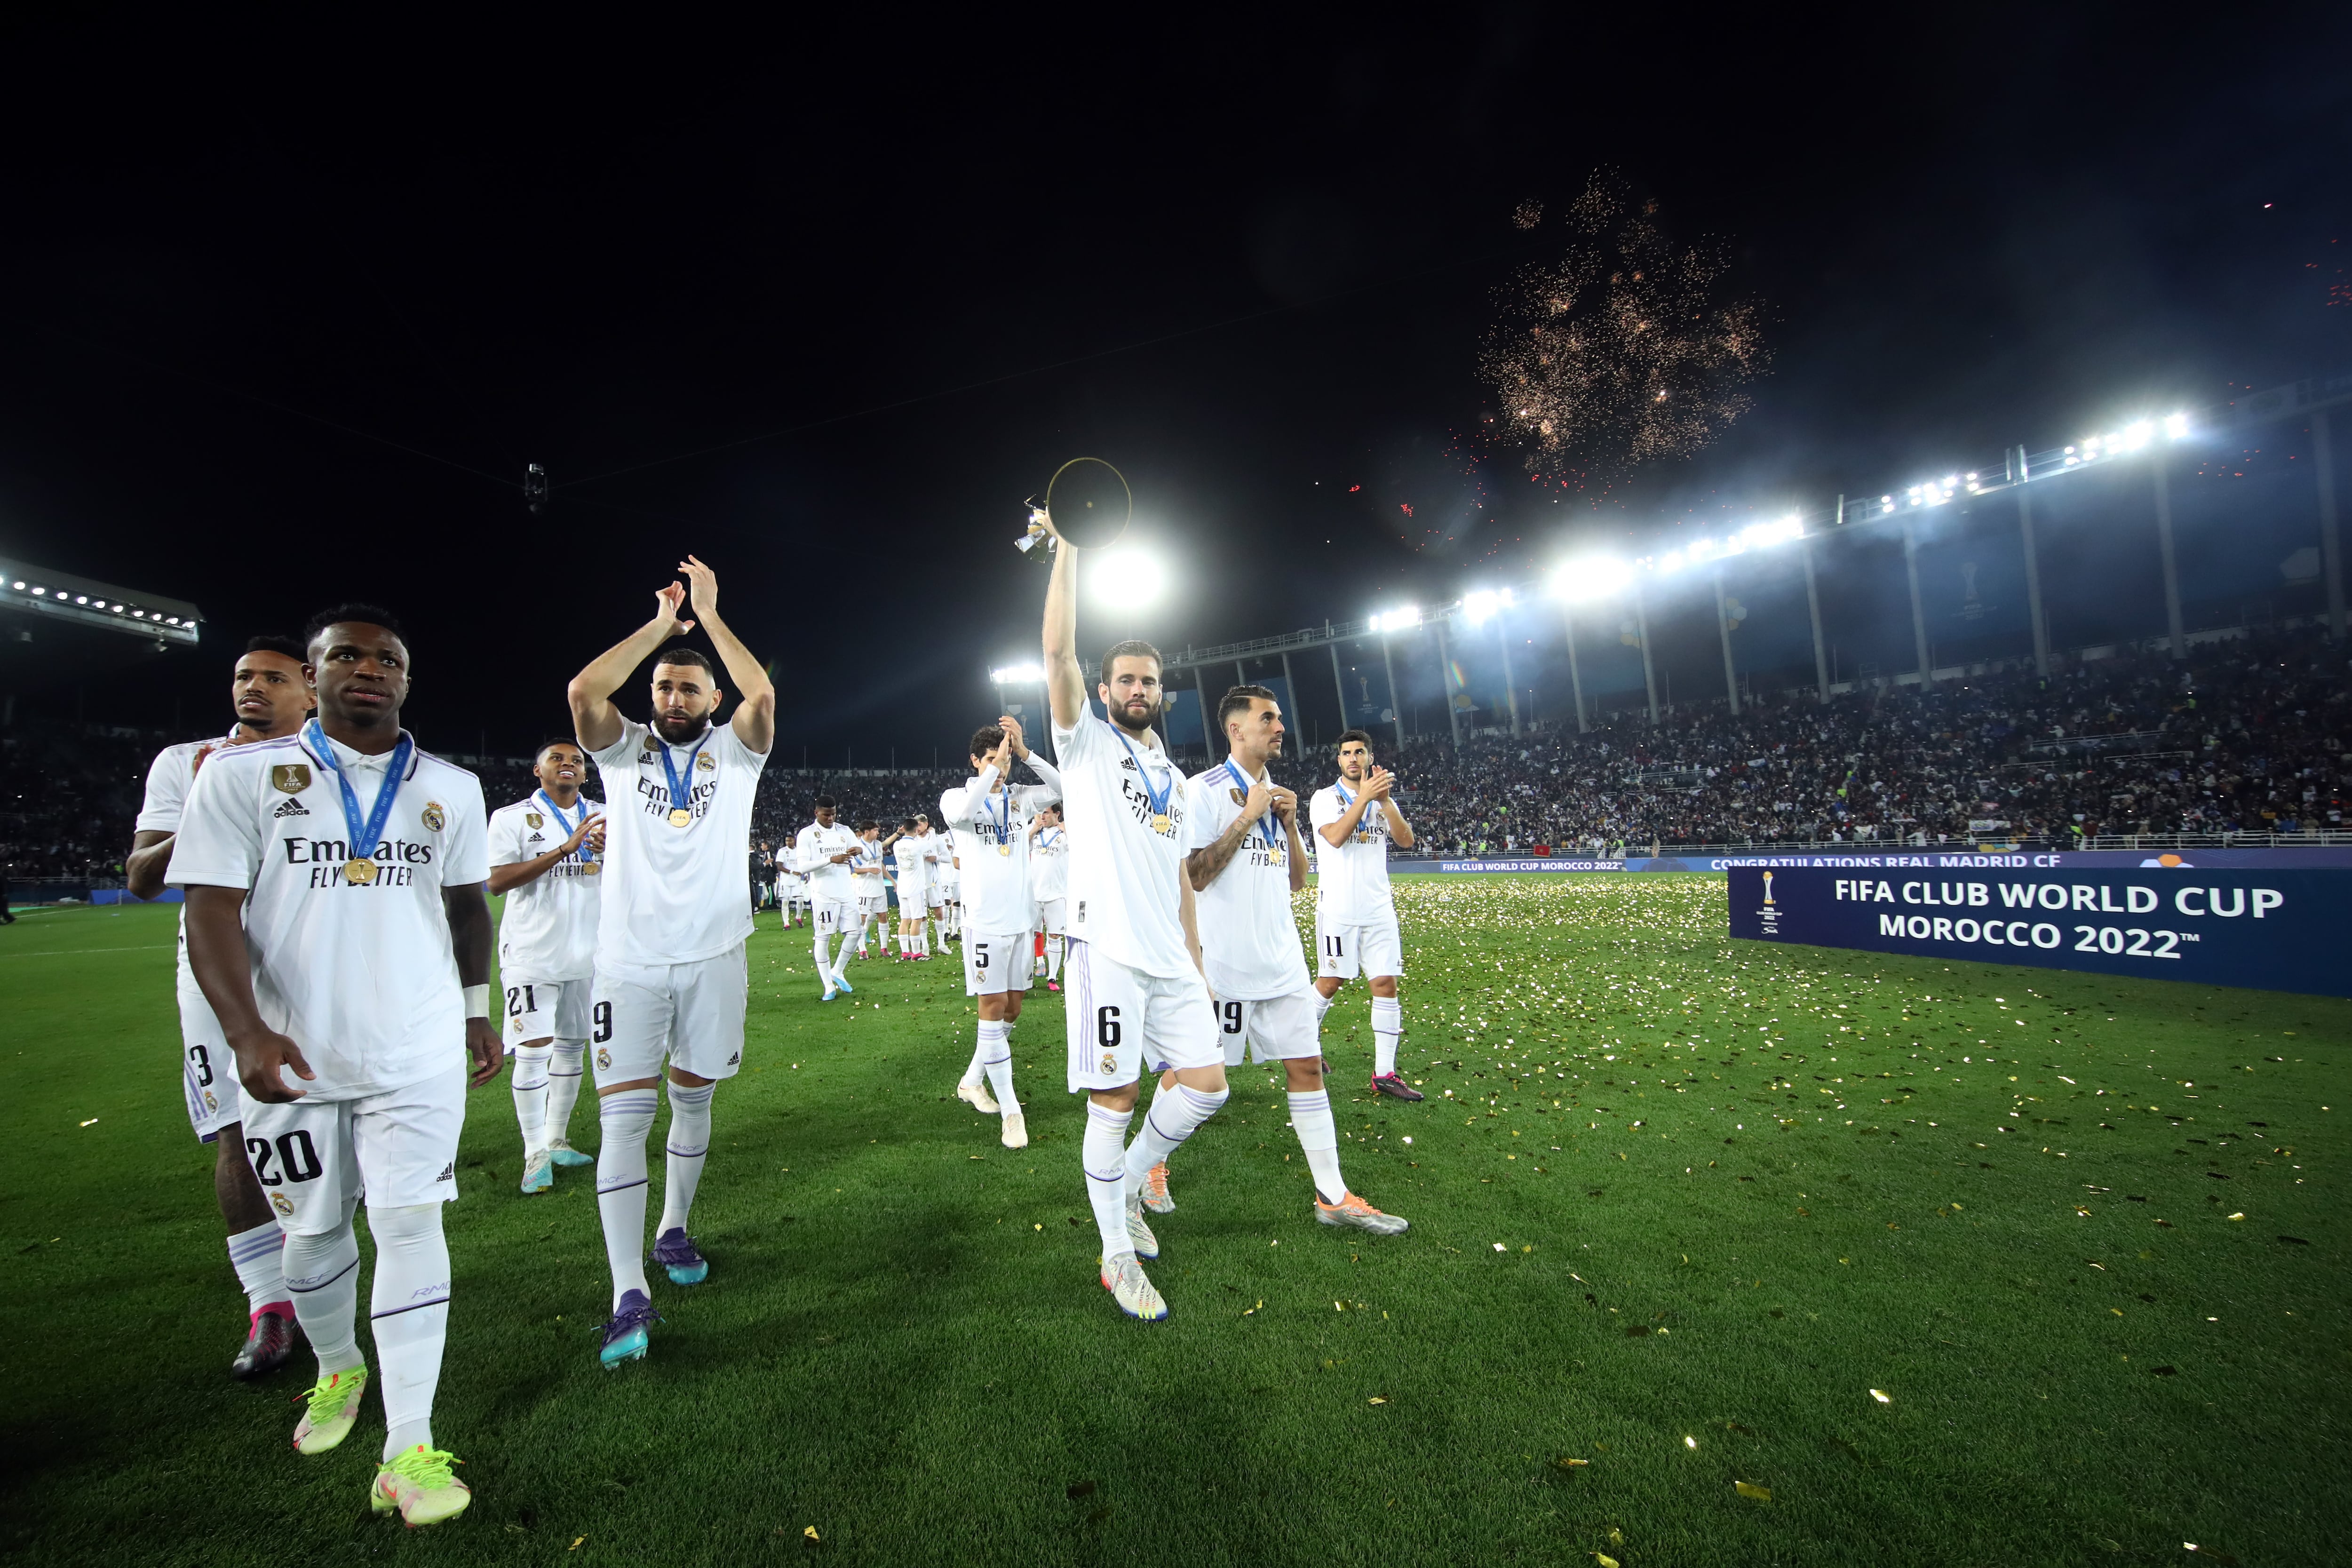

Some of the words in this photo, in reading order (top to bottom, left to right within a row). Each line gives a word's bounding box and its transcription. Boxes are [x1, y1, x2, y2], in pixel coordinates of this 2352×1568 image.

[638, 775, 716, 804] Emtes
[1123, 779, 1184, 825] Emtes
[274, 809, 310, 818] adidas
[645, 801, 665, 817] FLY
[283, 837, 431, 864] Emates
[985, 836, 994, 845] FLY
[1541, 862, 1592, 870] MOROCCO
[1886, 857, 1934, 867] REAL
[1940, 856, 2027, 867] MADRID
[2034, 855, 2060, 867] CF
[310, 867, 342, 888] FLY
[348, 866, 412, 887] TTER
[1836, 880, 1895, 903] FIFA
[1902, 882, 1989, 906] CLUB
[1998, 883, 2158, 913] WORLD
[2175, 887, 2283, 918] CUP
[818, 911, 832, 923] 41
[1880, 914, 2061, 949] MOROCCO
[976, 944, 988, 968] 5
[1326, 936, 1343, 956] 11
[507, 984, 538, 1016] 21
[593, 1001, 612, 1043] 9
[1098, 1006, 1120, 1047] 6
[190, 1045, 213, 1087] 3
[246, 1130, 323, 1186] 20
